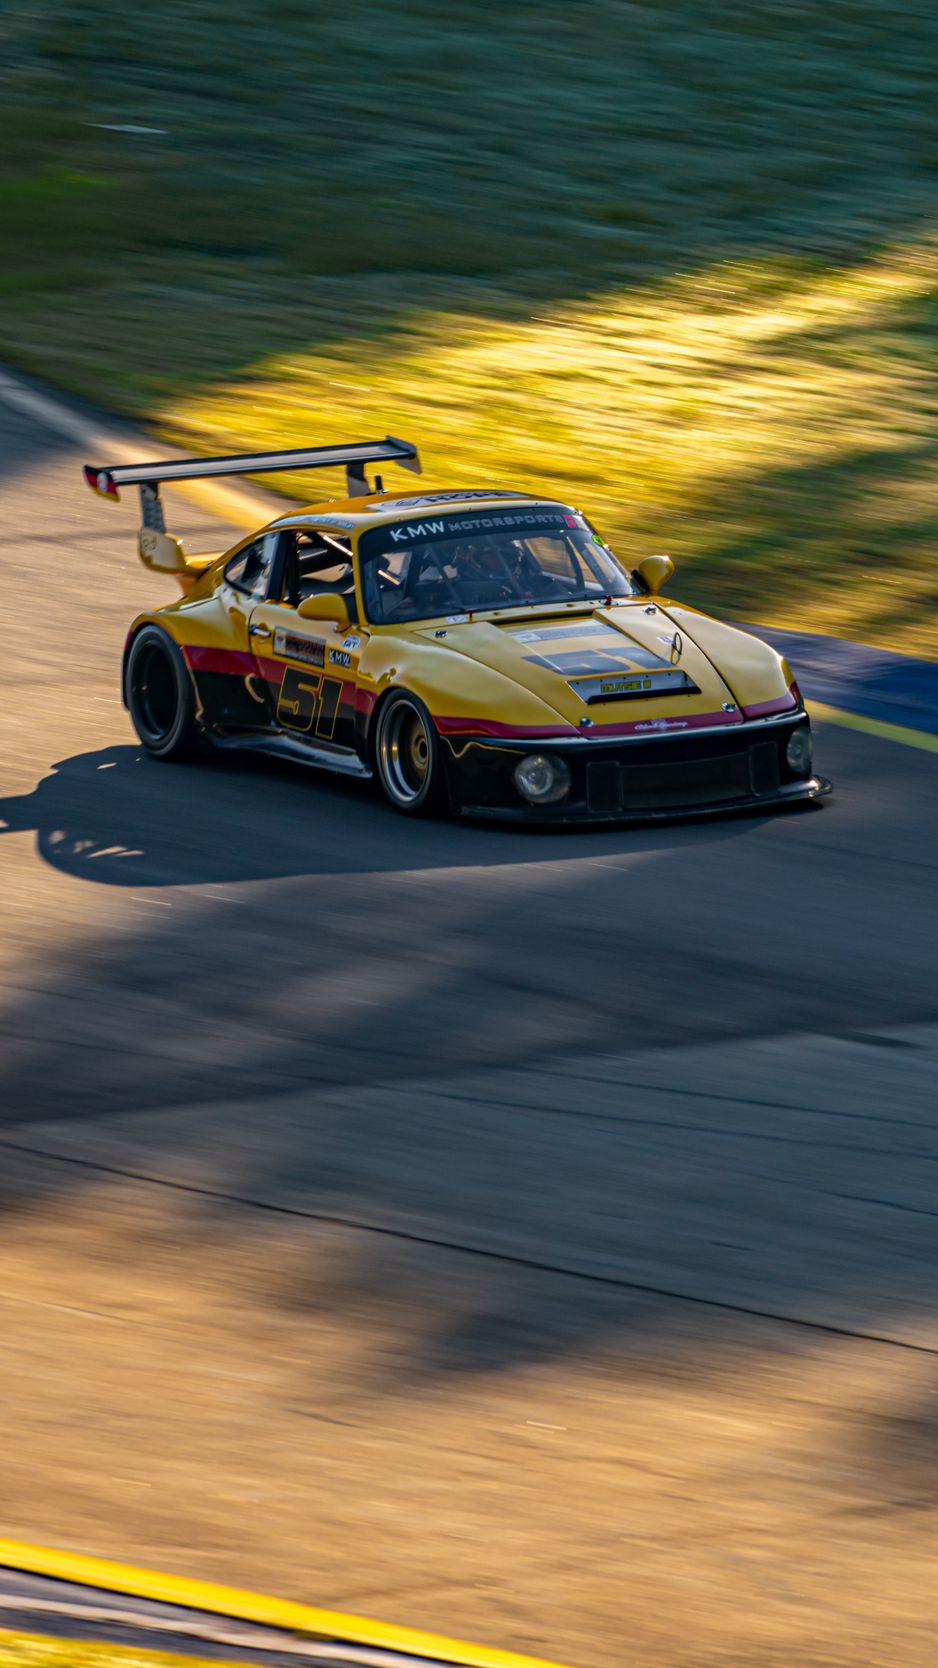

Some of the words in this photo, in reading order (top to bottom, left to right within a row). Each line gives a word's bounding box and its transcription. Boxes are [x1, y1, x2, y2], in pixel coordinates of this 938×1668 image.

[390, 521, 444, 541] KMW
[448, 514, 563, 532] MOTORSPORTS
[329, 650, 350, 666] KMW
[277, 666, 343, 739] 51
